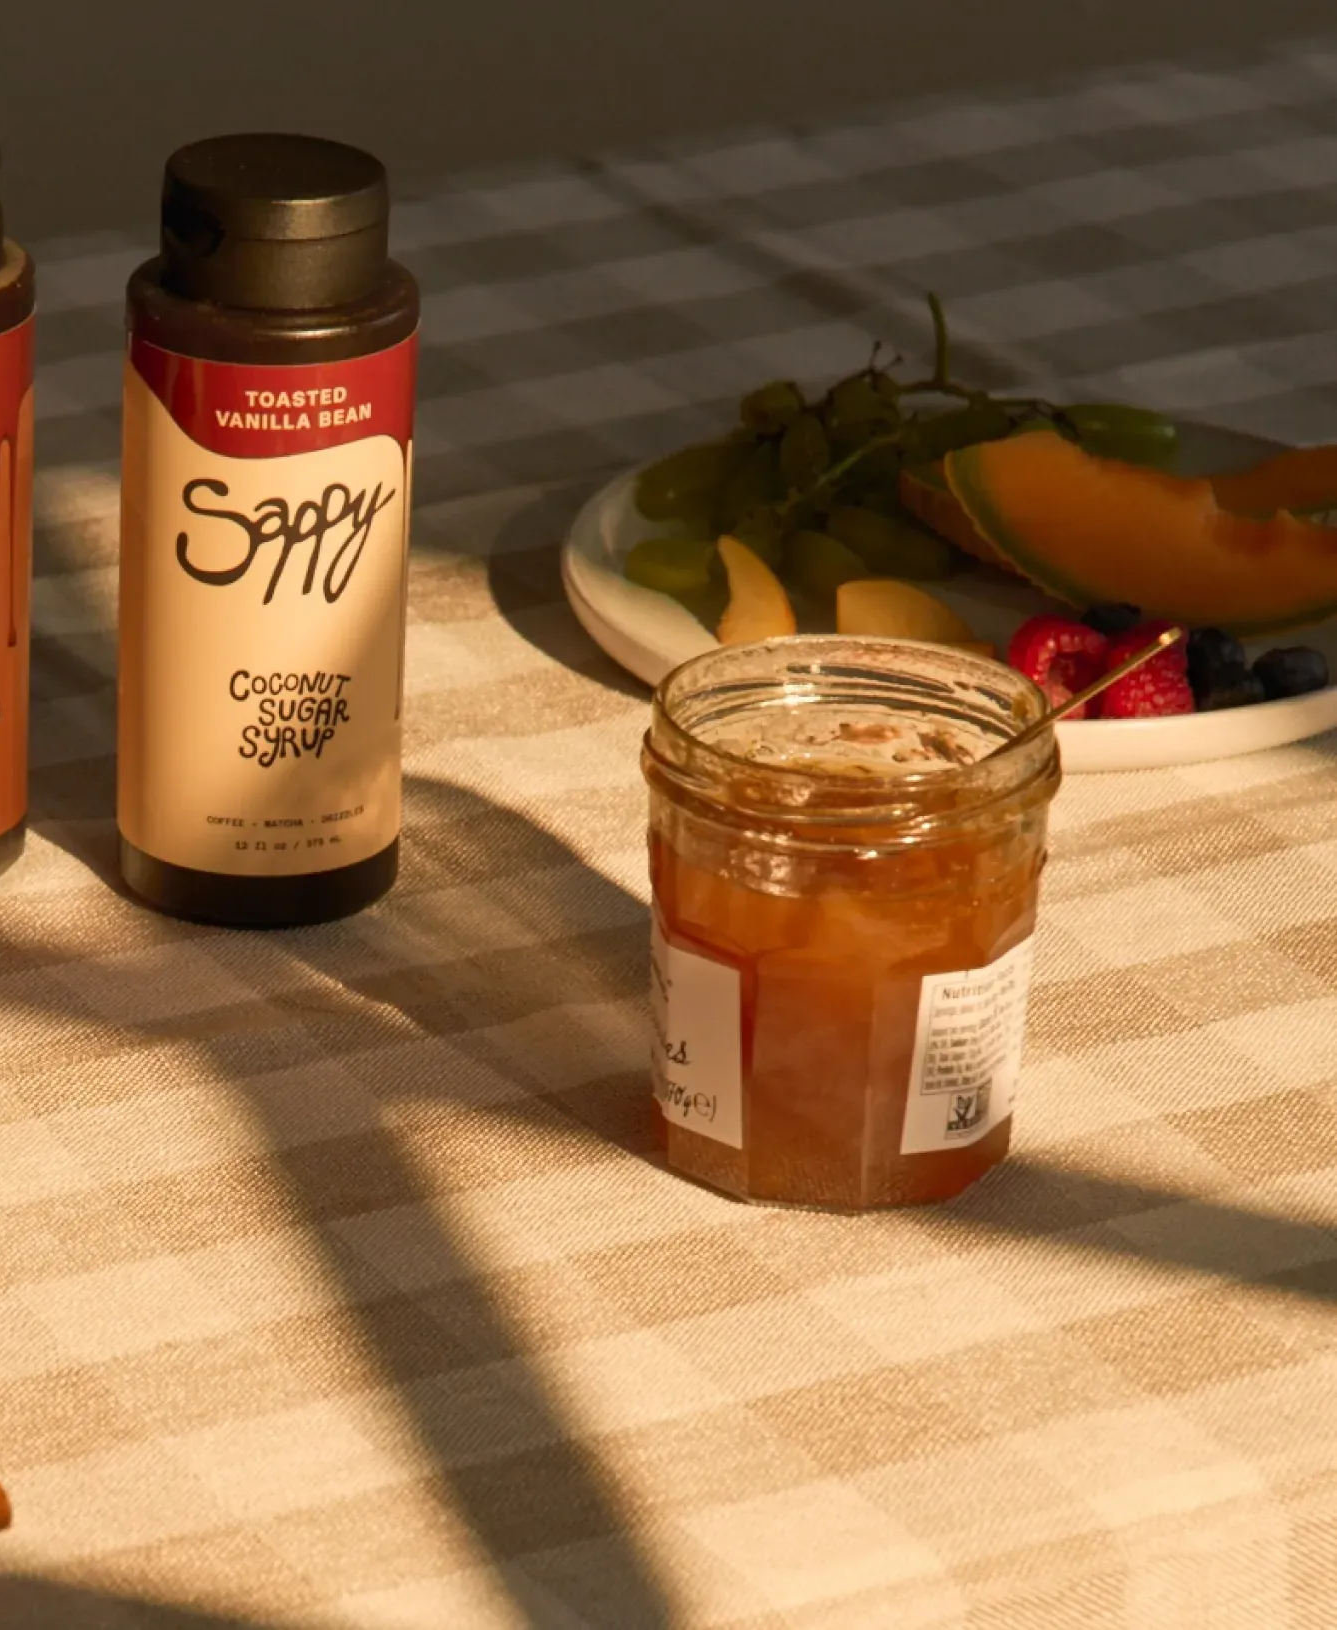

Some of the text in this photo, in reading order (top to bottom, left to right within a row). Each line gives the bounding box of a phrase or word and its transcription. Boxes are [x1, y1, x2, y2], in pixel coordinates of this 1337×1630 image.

[245, 387, 348, 408] TOASTED
[216, 403, 372, 430] VANILLA BEAN
[175, 478, 396, 605] Sappy
[230, 670, 351, 701] COCONUT
[259, 697, 350, 726] SUGAR
[206, 815, 244, 828] COFFEE
[264, 818, 304, 828] MATCHA
[235, 839, 248, 850] 12
